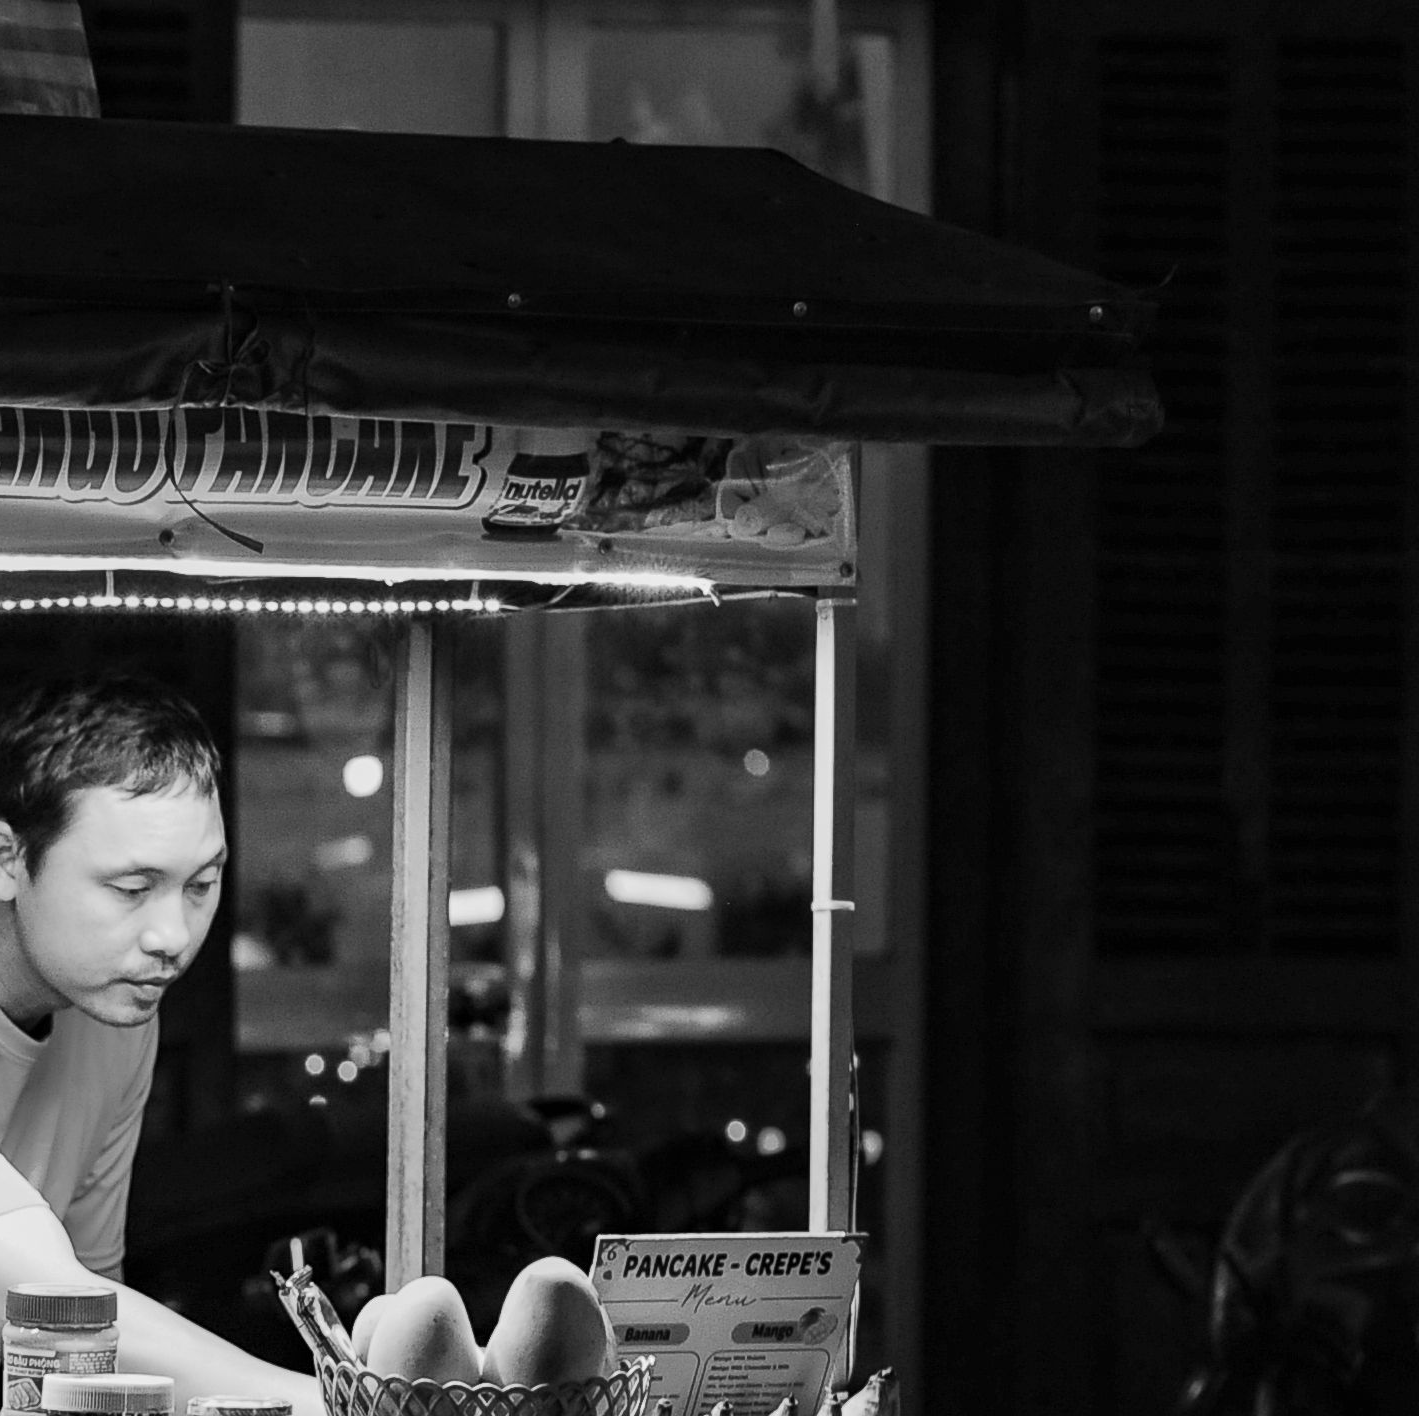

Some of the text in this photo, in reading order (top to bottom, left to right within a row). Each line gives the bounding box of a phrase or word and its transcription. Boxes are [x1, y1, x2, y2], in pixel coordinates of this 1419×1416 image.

[505, 478, 580, 502] nutella
[623, 1251, 833, 1278] PANCAKE - CREPE'S
[681, 1283, 757, 1314] Menu
[624, 1323, 794, 1342] Banana Mango
